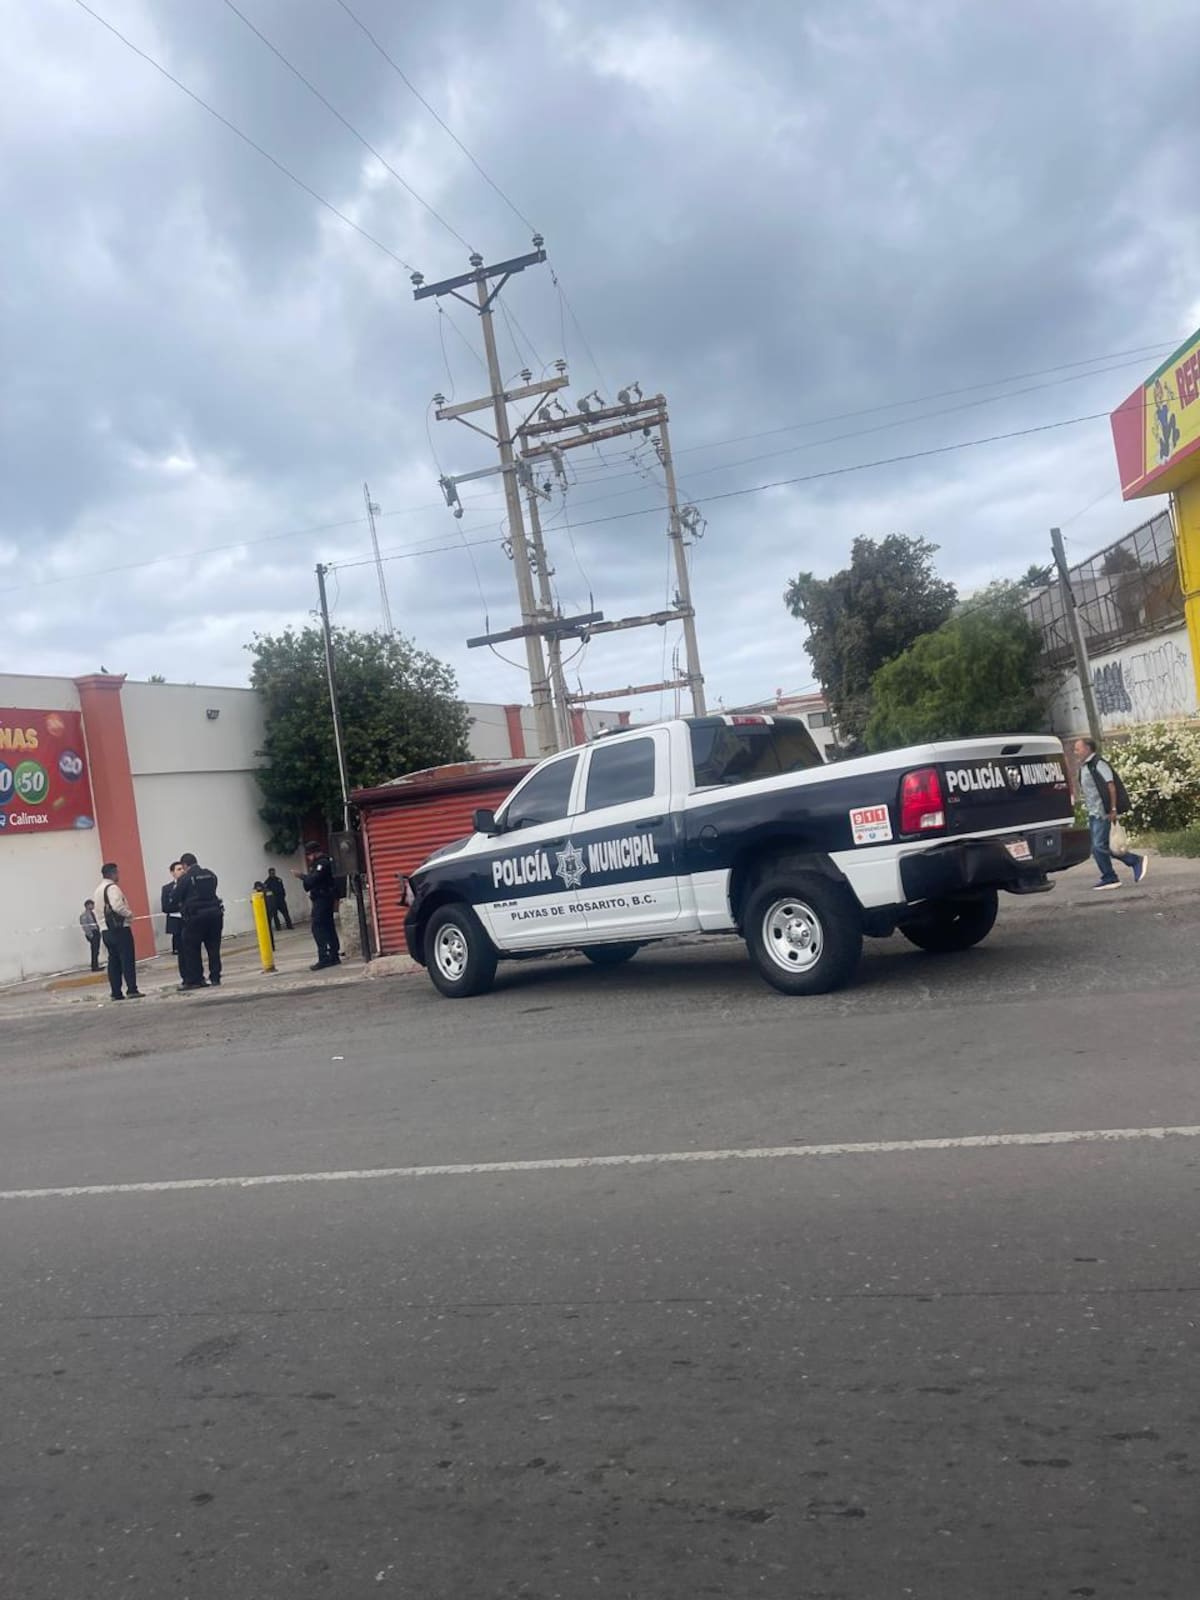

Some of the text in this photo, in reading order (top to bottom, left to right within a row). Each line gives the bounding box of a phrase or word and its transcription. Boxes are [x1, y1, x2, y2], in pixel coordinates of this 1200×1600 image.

[945, 762, 1065, 793] POLICÍA MUNICIPAL
[9, 811, 49, 826] Calimax
[855, 809, 883, 825] 911
[492, 833, 659, 889] POLICÍA MUNICIPAL
[511, 893, 657, 920] PLAYAS DE ROSARITO, B.C.
